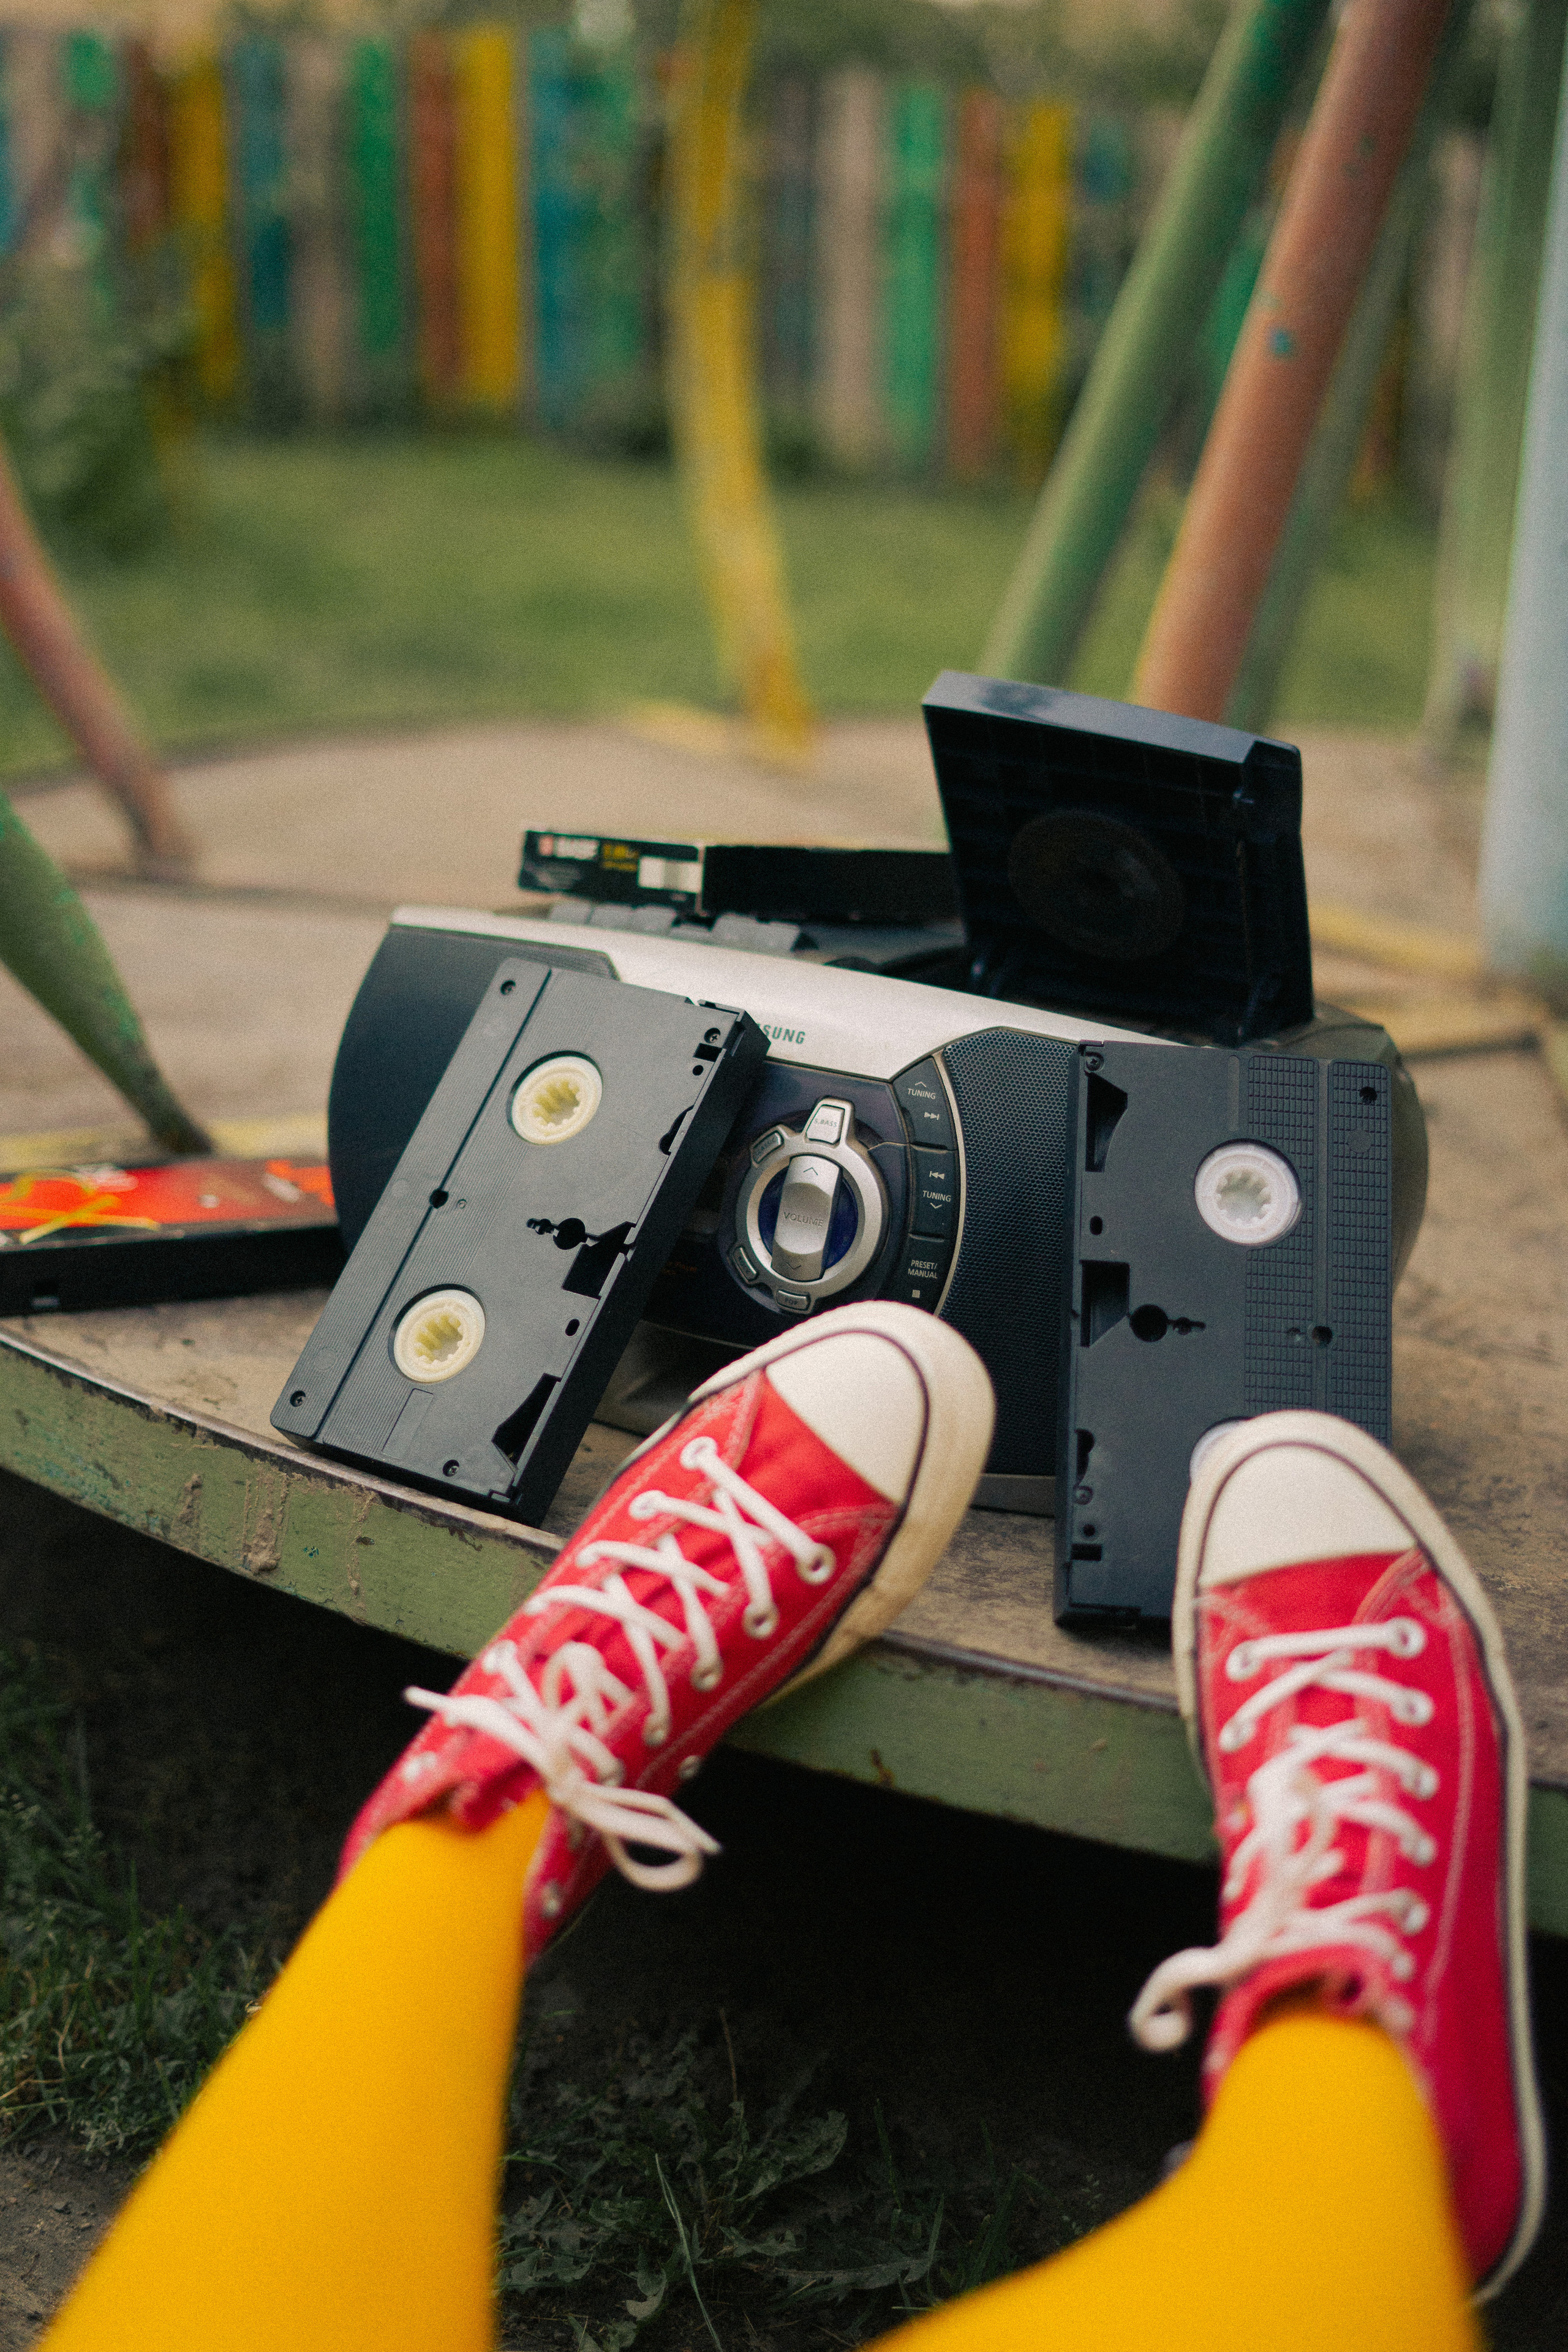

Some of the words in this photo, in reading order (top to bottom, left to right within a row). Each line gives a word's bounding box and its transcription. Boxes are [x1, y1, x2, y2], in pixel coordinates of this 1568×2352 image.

[757, 1023, 806, 1044] SUNG
[907, 1088, 936, 1100] TUNING
[814, 1118, 838, 1128] S.BASS
[922, 1190, 951, 1202] TUNING
[783, 1212, 824, 1227] VOLUME
[911, 1259, 938, 1270] PRESET/
[908, 1268, 938, 1280] MANUAL
